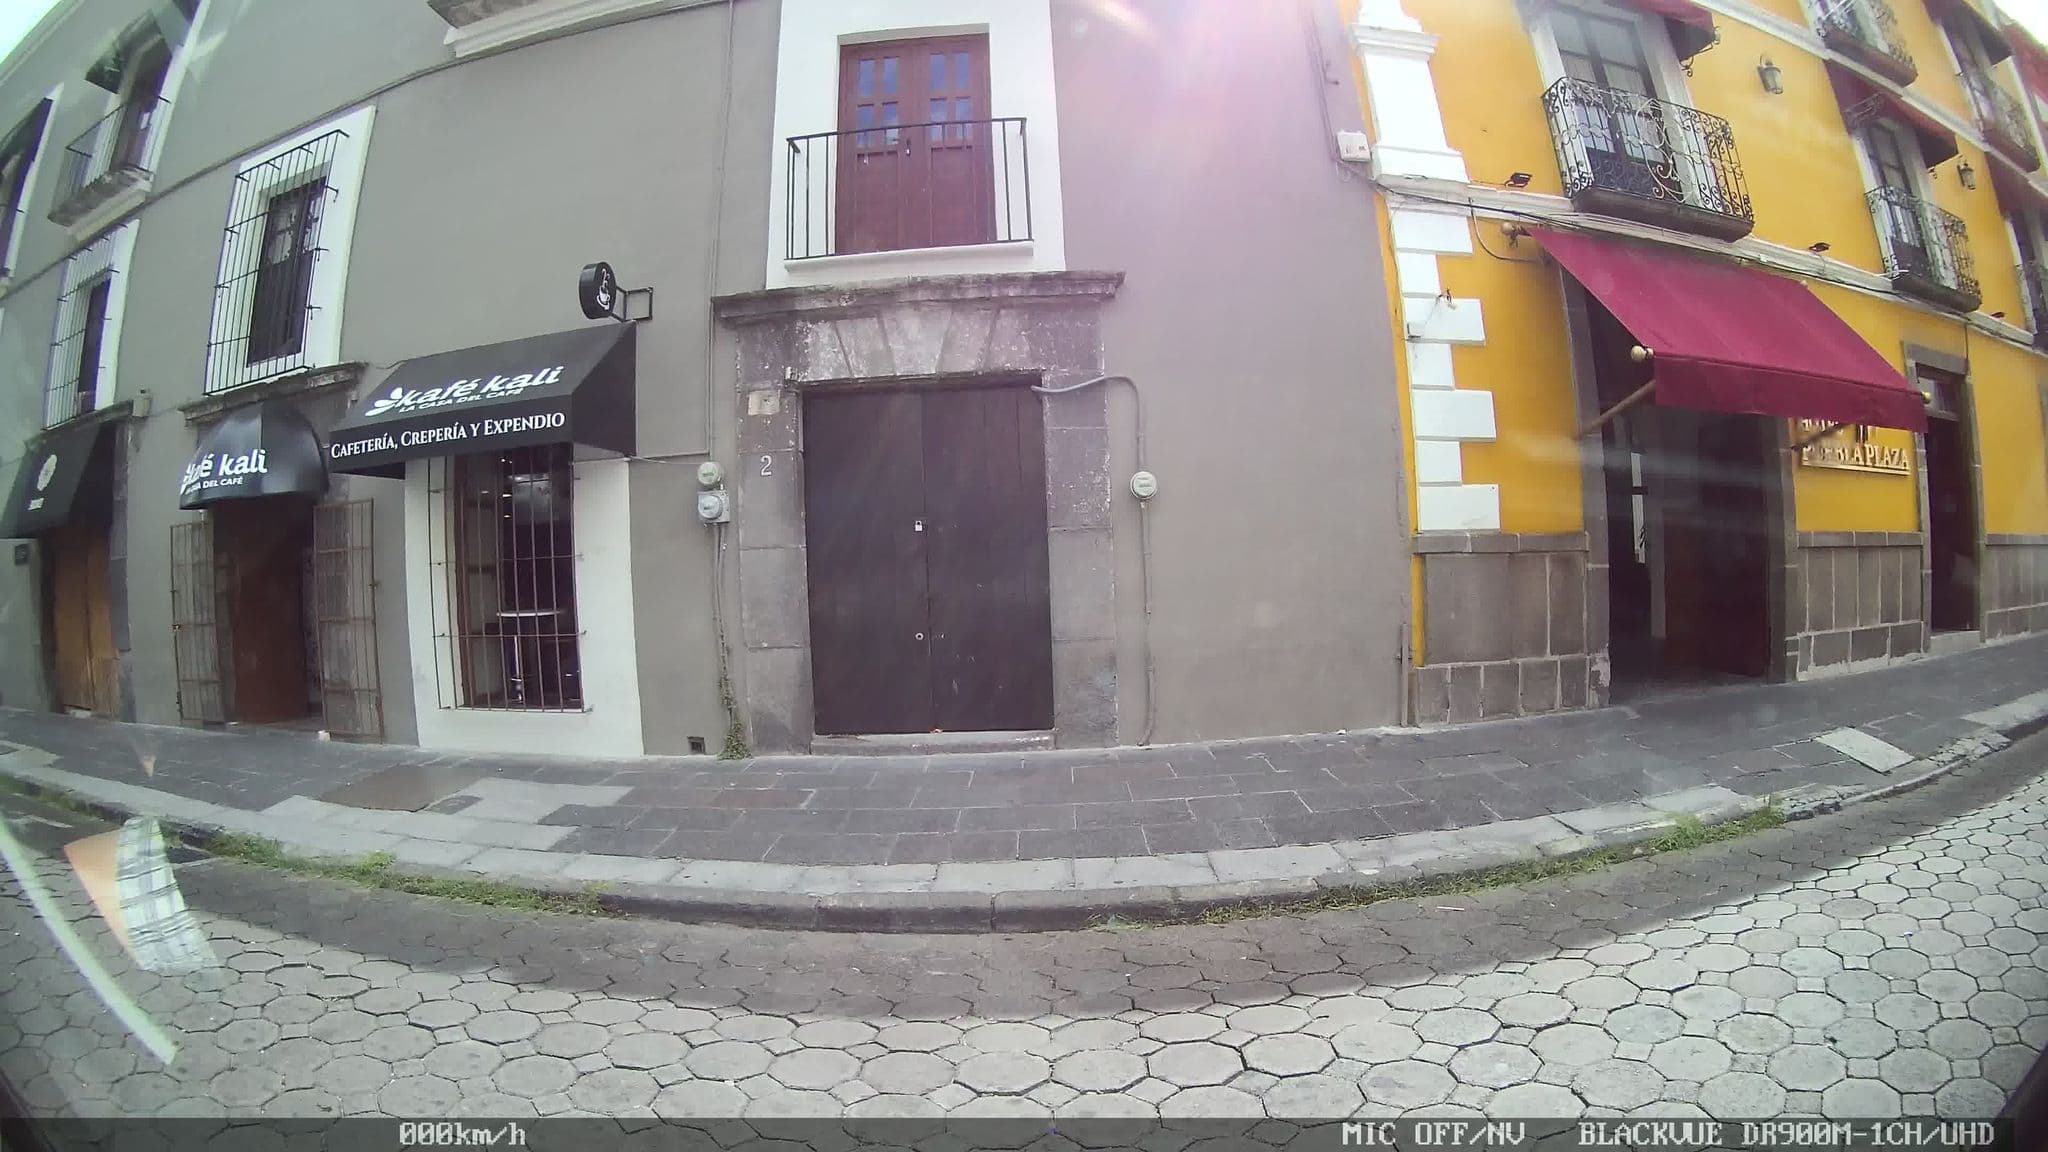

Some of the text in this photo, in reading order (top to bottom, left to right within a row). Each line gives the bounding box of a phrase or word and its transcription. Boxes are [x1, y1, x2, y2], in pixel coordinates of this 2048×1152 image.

[395, 366, 564, 408] kafé kali
[399, 405, 415, 413] LA
[419, 398, 453, 409] CASA
[456, 394, 482, 403] DEL
[331, 412, 565, 459] CAFETERÍA, CREPERÍA Y EXPENDIO
[219, 449, 268, 476] kali
[761, 455, 773, 476] 2
[1864, 443, 1910, 470] PLAZA
[220, 476, 243, 486] CAFÉ
